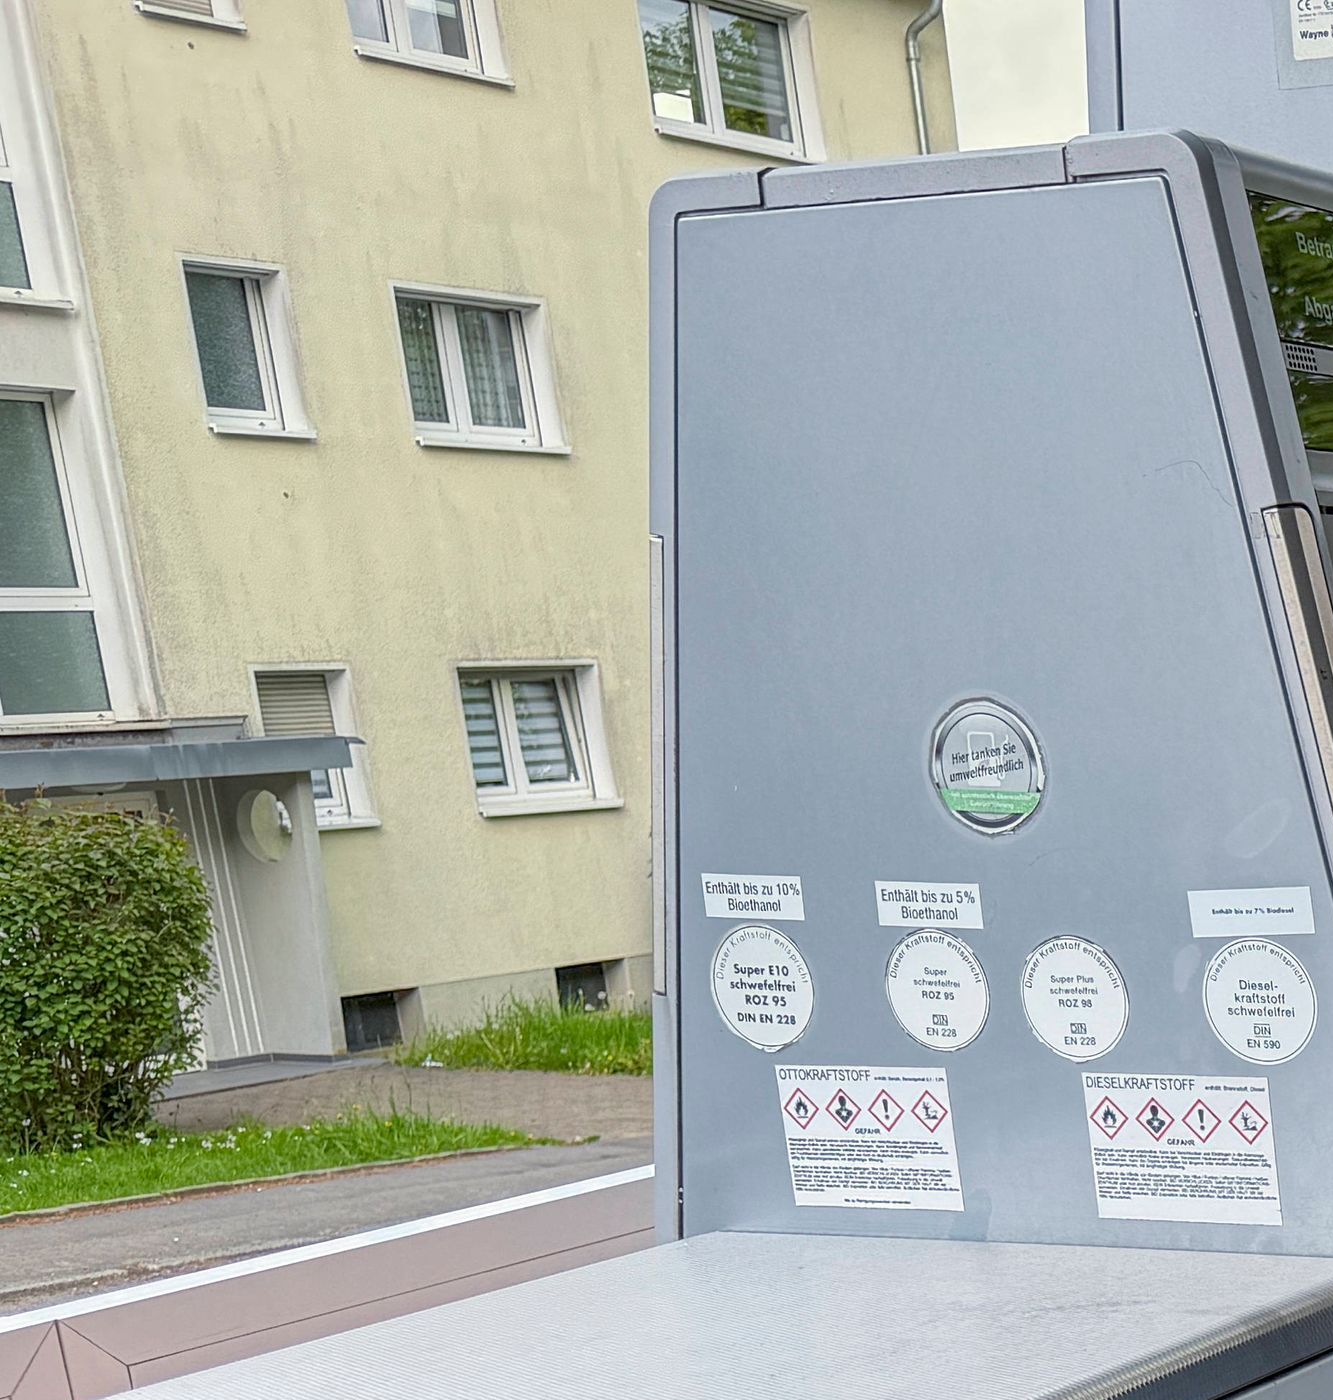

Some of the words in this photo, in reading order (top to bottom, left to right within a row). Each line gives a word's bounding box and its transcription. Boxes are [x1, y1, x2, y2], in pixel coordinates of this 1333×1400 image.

[1300, 29, 1330, 40] Wayne
[951, 752, 970, 766] Hier
[971, 746, 1001, 760] tanken
[1003, 742, 1017, 755] Sie
[950, 758, 1025, 783] umweltfreundlich
[705, 881, 741, 896] Enthält
[743, 882, 760, 896] bis
[761, 885, 773, 896] zu
[776, 882, 801, 897] 10%
[881, 888, 918, 902] Enthält
[921, 889, 938, 904] bis
[940, 893, 953, 904] zu
[956, 890, 976, 904] 5%
[727, 897, 782, 912] Bioethanol
[901, 906, 959, 921] Bioethanol
[716, 947, 731, 980] Dieser
[730, 930, 772, 950] Kraftstoff
[773, 937, 809, 984] entspricht
[889, 949, 905, 979] Dieser
[905, 935, 945, 951] Kraftstoff
[946, 940, 982, 984] entspricht
[733, 963, 765, 978] Super
[768, 965, 789, 977] E10
[1024, 957, 1041, 989] Dieser
[1038, 942, 1081, 960] Kraftstoff
[1082, 946, 1121, 990] entspricht
[1209, 955, 1228, 982] Dieser
[1227, 943, 1268, 958] Kraftstoff
[1269, 948, 1306, 985] entspricht
[923, 966, 948, 977] Super
[729, 978, 797, 993] schwefelfrei
[913, 978, 961, 989] schwefelfrei
[1050, 974, 1075, 985] Super
[1076, 974, 1094, 984] Plus
[1238, 979, 1279, 992] Diesel-
[921, 990, 942, 1000] ROZ
[943, 991, 955, 1001] 95
[1049, 986, 1099, 996] schwefelfrei
[744, 994, 769, 1006] ROZ
[772, 995, 788, 1007] 95
[1058, 998, 1080, 1008] ROZ
[1234, 992, 1286, 1005] kraftstoff
[1227, 1005, 1296, 1018] schwefelfrei
[736, 1011, 757, 1024] DIN
[759, 1012, 774, 1025] EN
[776, 1014, 797, 1026] 228
[932, 1014, 949, 1026] DIN
[926, 1026, 940, 1037] EN
[941, 1027, 957, 1038] 228
[1070, 1022, 1087, 1035] DIN
[1253, 1025, 1272, 1036] DIN
[1064, 1036, 1078, 1046] EN
[1079, 1036, 1097, 1046] 228
[1246, 1038, 1261, 1049] EN
[1263, 1039, 1281, 1050] 590
[778, 1068, 871, 1082] OTTOKRAFTSTOFF
[1085, 1076, 1196, 1091] DIESELKRAFTSTOFF
[854, 1127, 882, 1136] GEFAHR
[1166, 1138, 1196, 1147] GEFAHR
